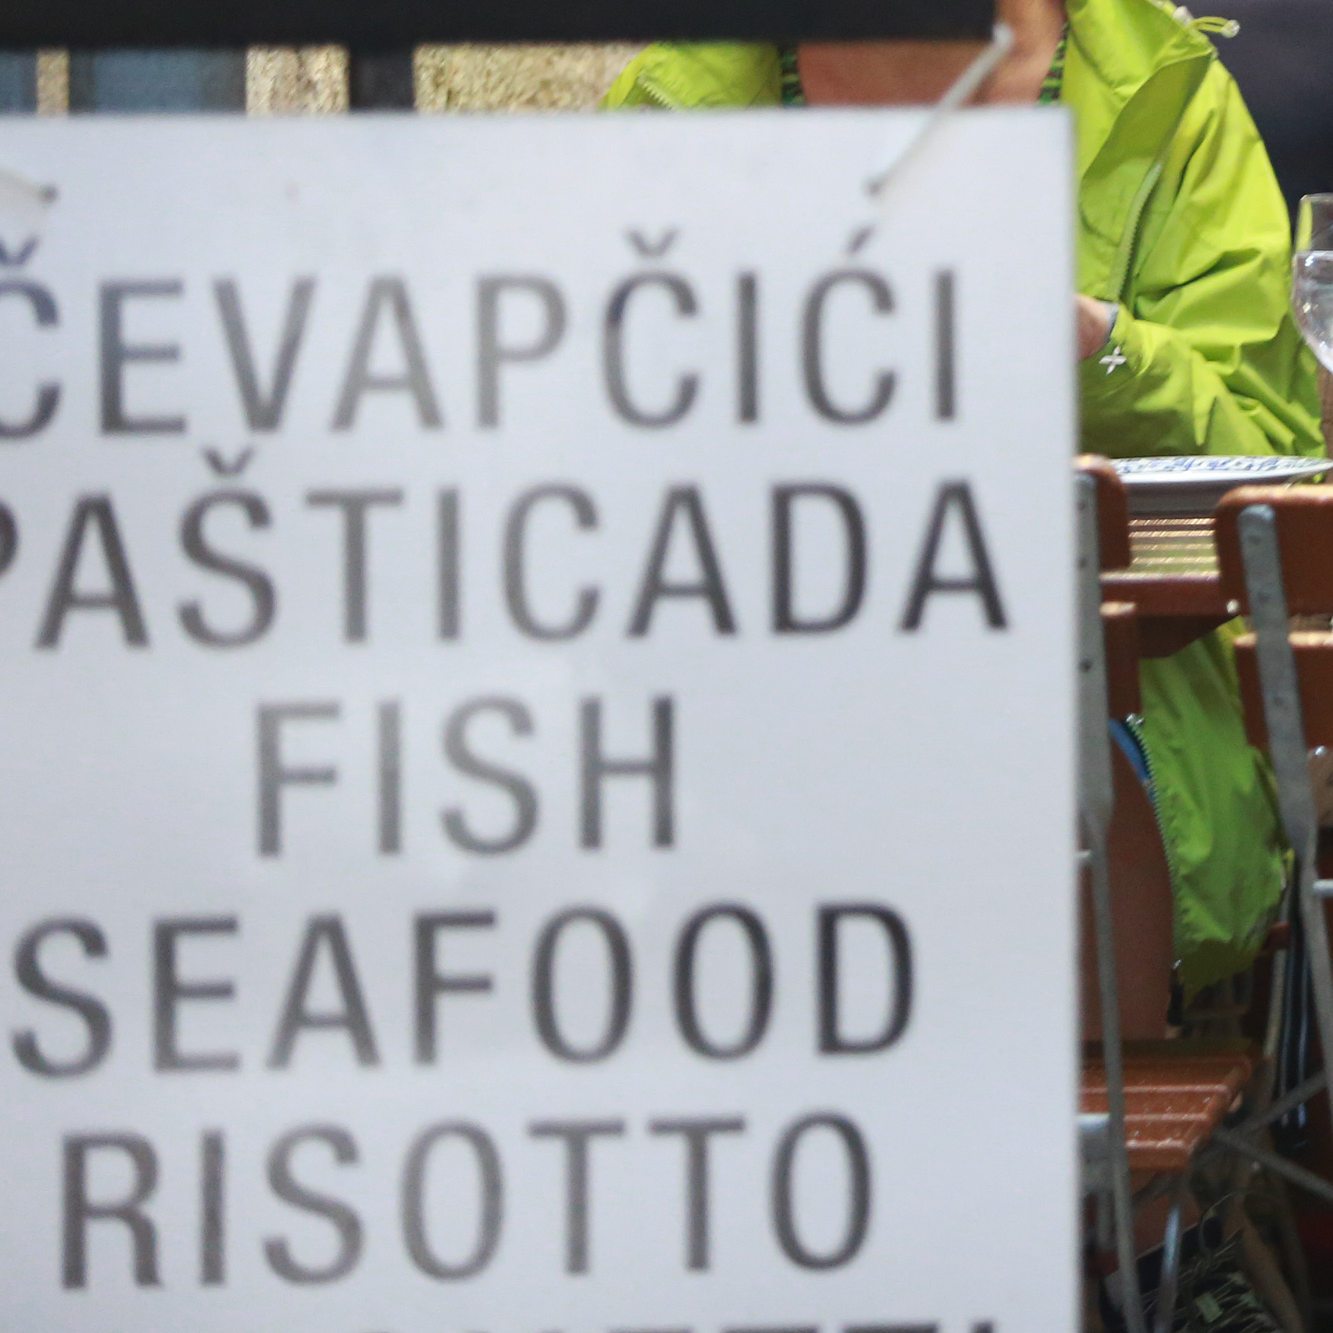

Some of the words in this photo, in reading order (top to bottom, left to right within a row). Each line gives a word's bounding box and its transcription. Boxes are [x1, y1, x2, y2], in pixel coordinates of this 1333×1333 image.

[0, 446, 1011, 653] AŠTICADA
[256, 693, 677, 859] FISH
[10, 900, 917, 1081] SEAFOOD
[58, 1110, 874, 1293] RISOTTO
